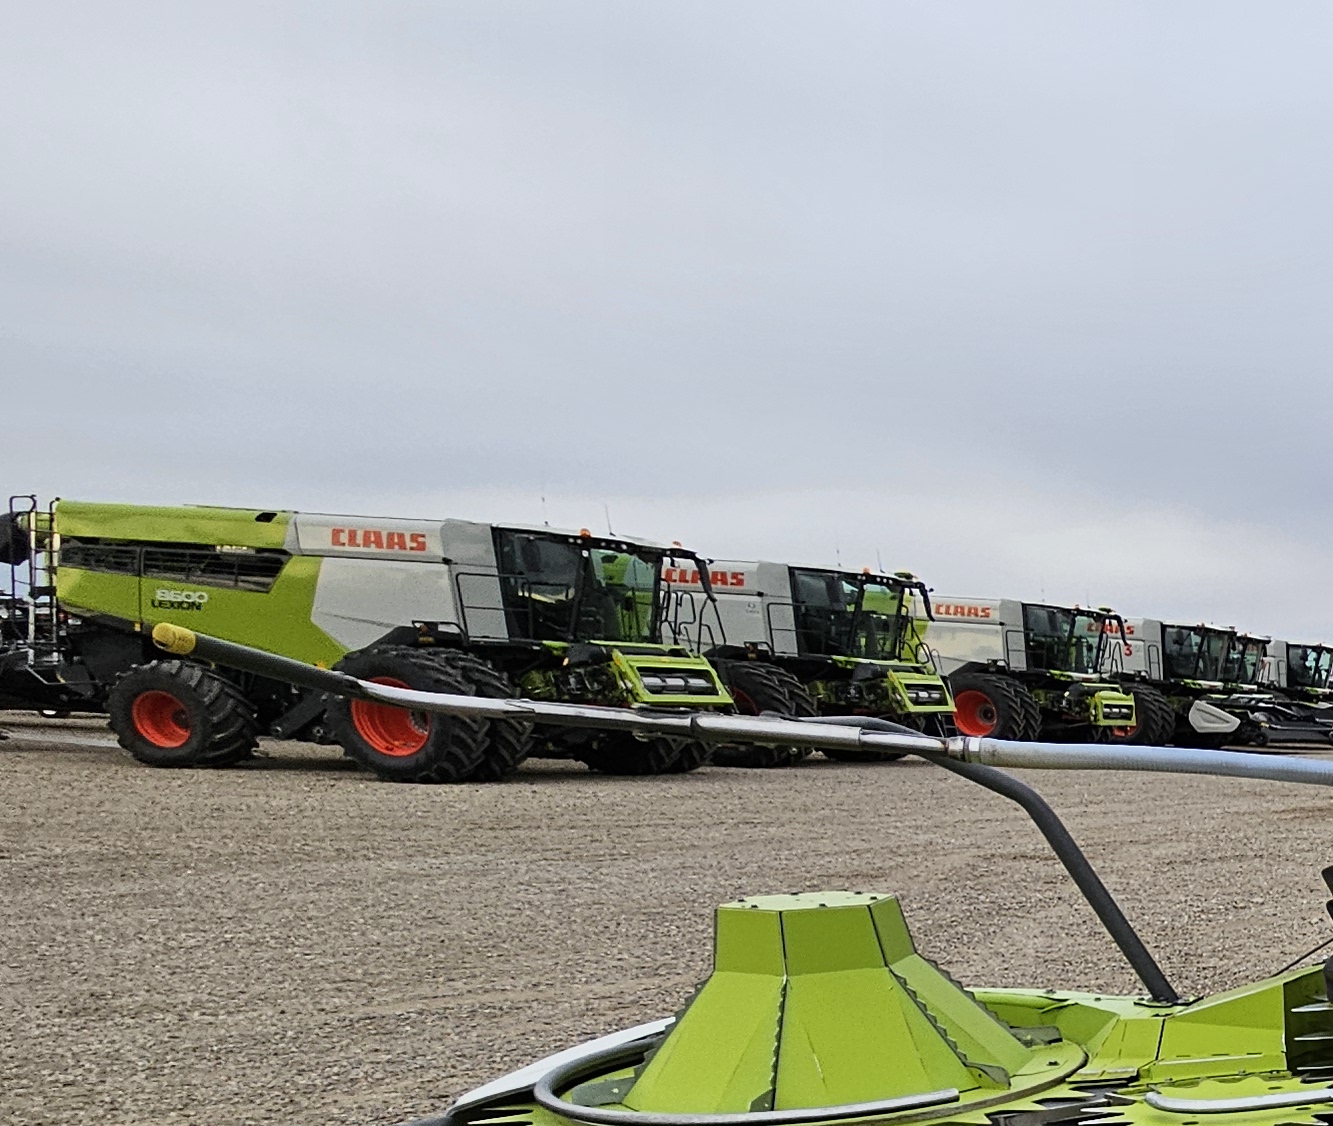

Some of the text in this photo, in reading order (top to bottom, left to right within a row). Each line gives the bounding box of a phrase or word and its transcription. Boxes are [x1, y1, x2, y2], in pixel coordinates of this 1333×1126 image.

[330, 527, 427, 552] CLAAS
[151, 600, 203, 611] LEXION
[935, 604, 991, 618] CLAAS
